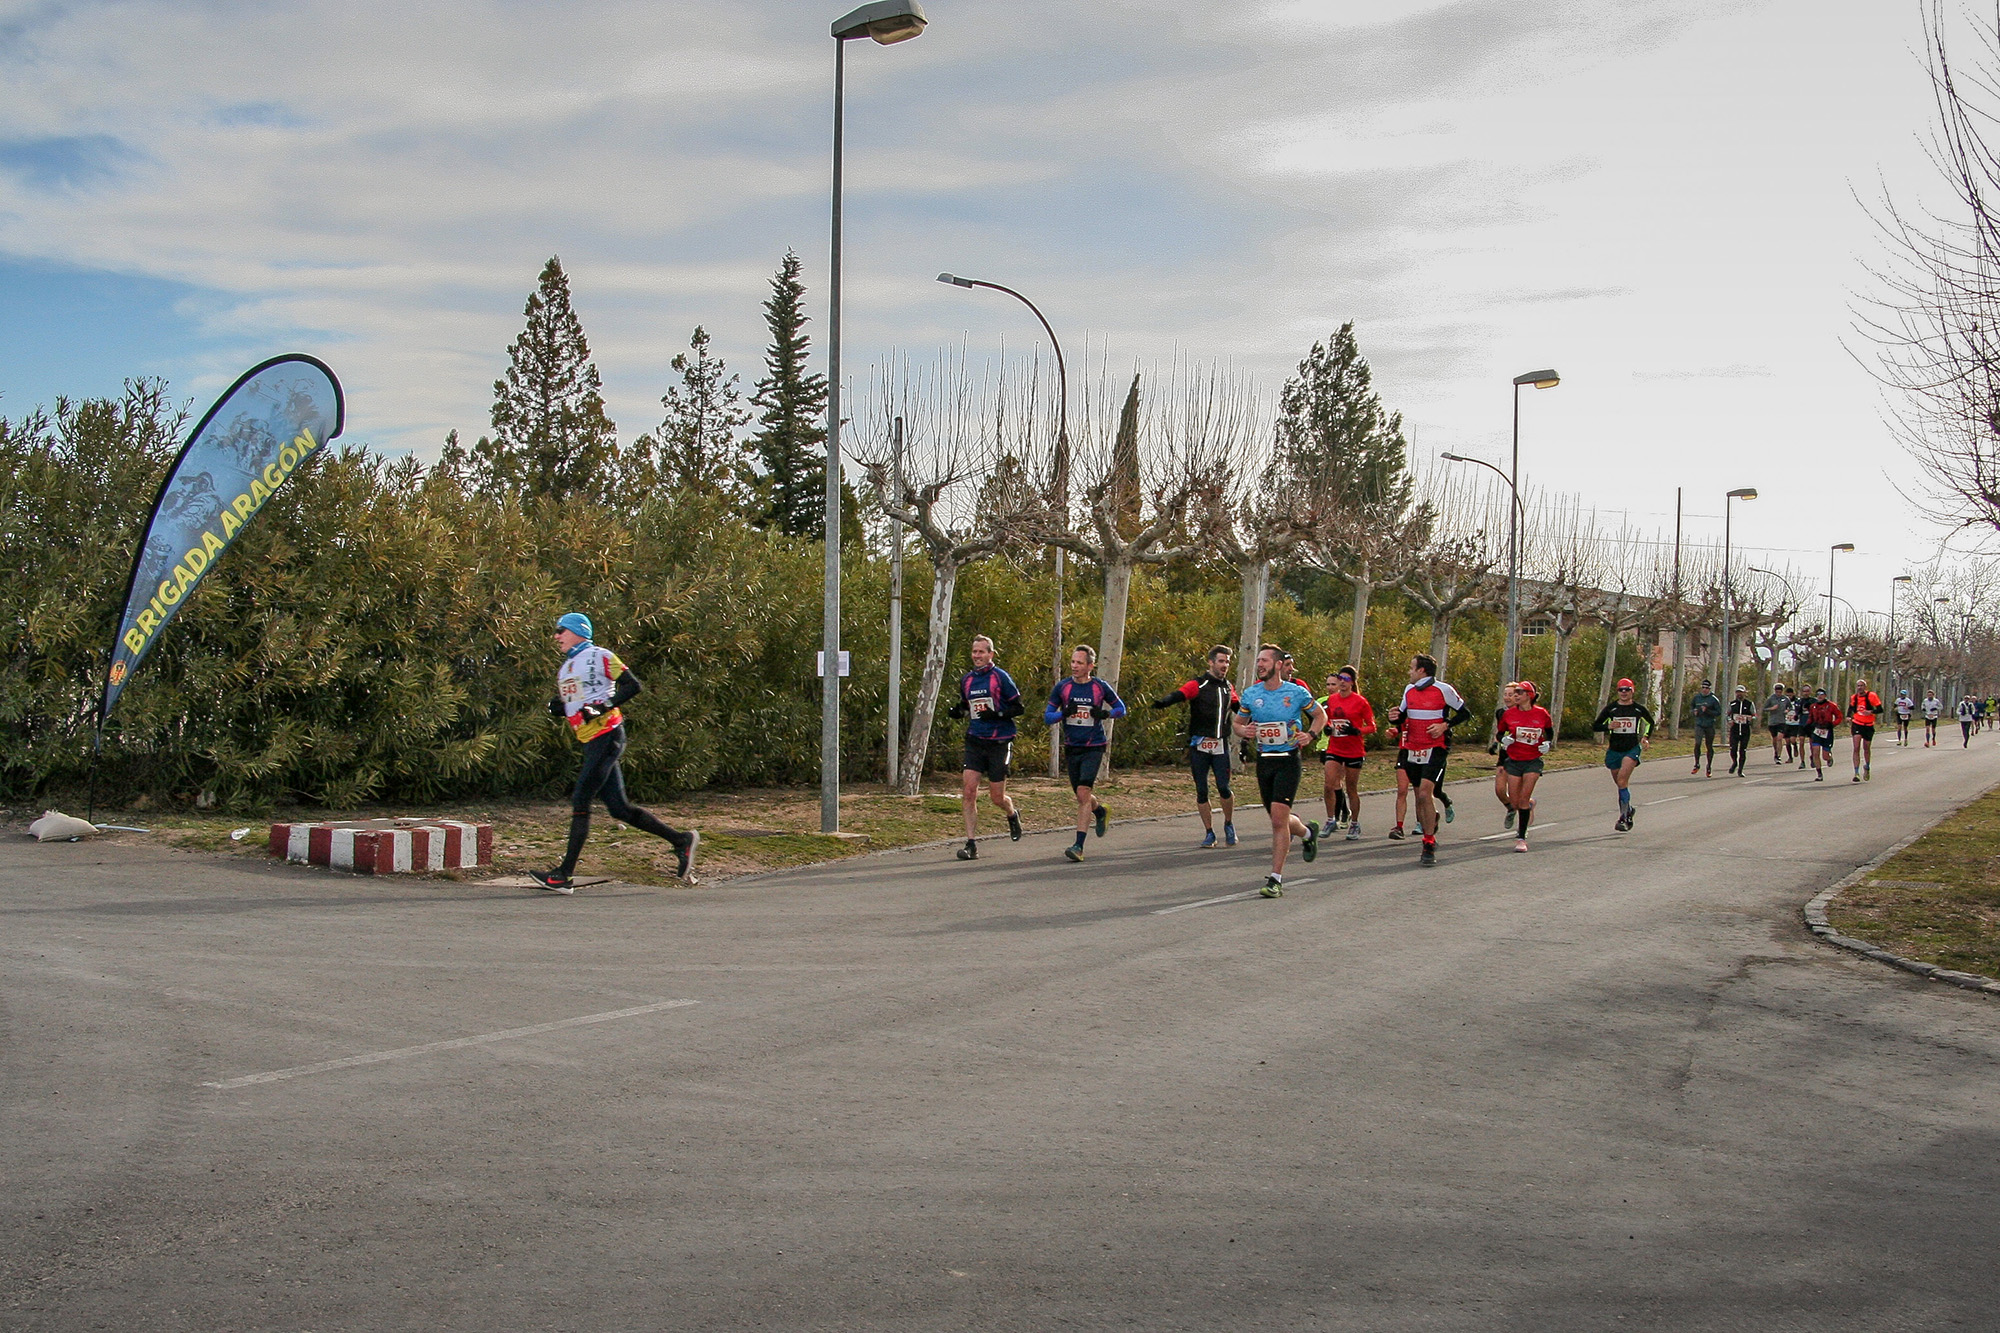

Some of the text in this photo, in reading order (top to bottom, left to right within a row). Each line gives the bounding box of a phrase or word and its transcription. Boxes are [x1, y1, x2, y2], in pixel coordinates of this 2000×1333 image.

[122, 427, 318, 656] BRIGADA ARAGÓN
[1260, 729, 1281, 738] 568
[1521, 731, 1538, 740] 743
